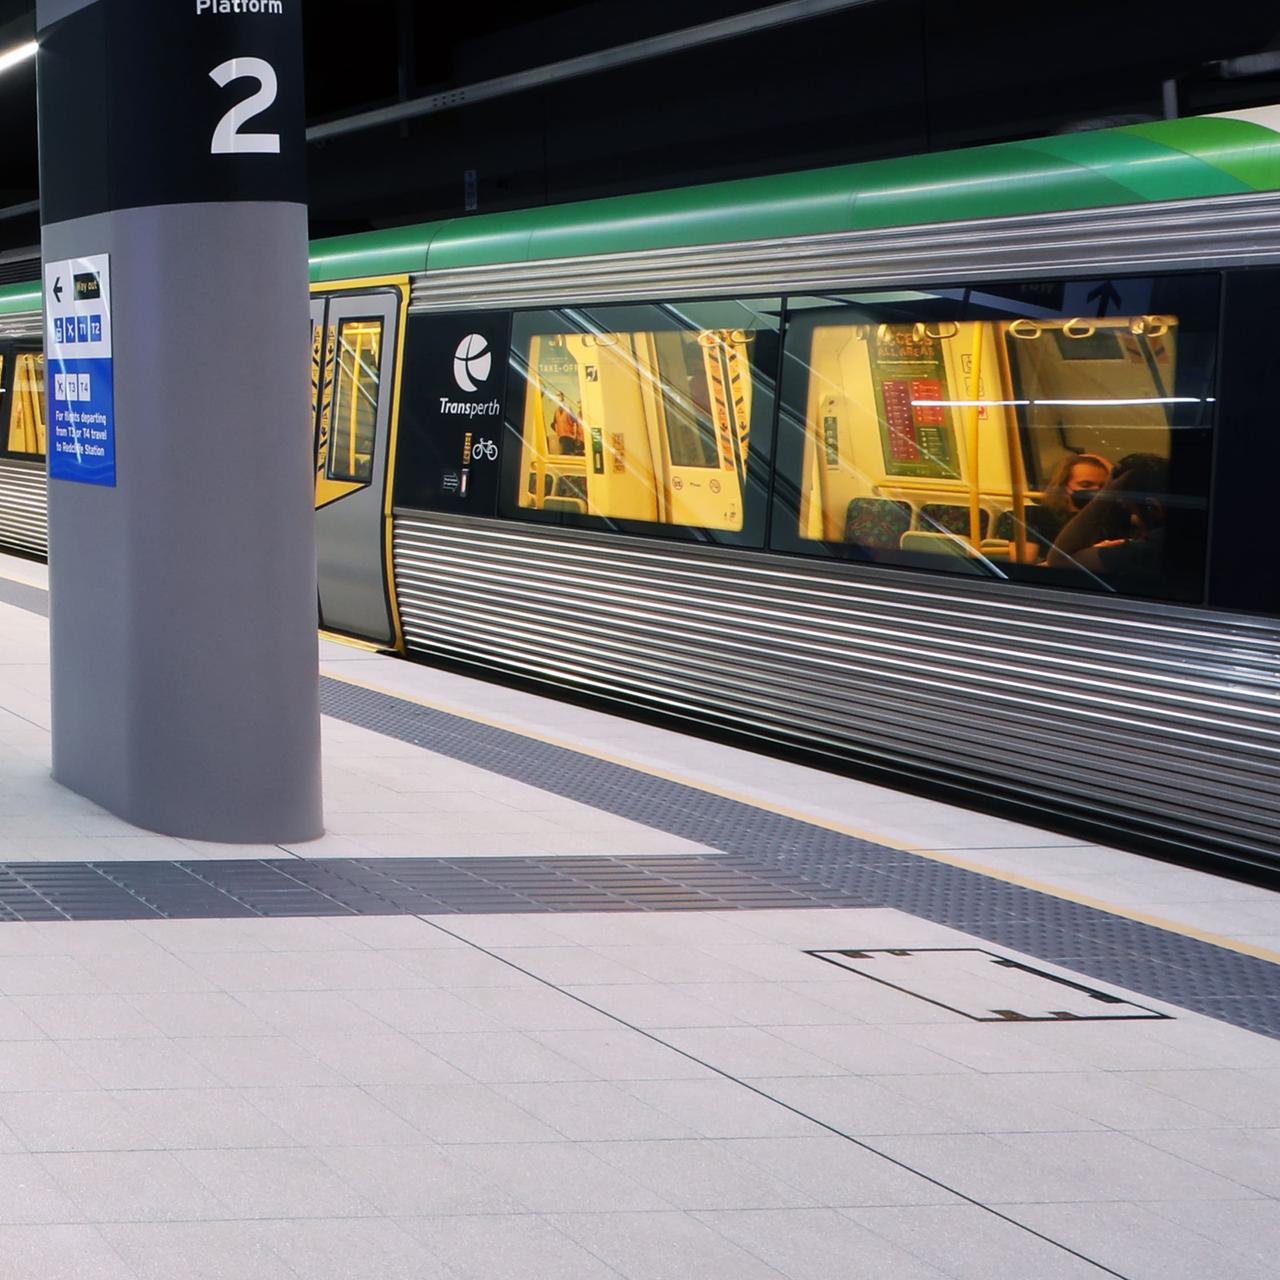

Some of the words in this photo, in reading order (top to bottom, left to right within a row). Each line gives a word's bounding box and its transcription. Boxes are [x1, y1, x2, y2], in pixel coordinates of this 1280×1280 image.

[208, 56, 281, 154] 2
[87, 280, 97, 290] out
[79, 323, 86, 335] T1
[91, 322, 100, 335] T2
[68, 381, 76, 393] T3
[80, 381, 88, 393] T4
[440, 397, 500, 419] Transperth
[55, 410, 64, 421] For
[80, 412, 107, 426] departing
[55, 425, 68, 437] from
[68, 427, 76, 438] T3
[82, 427, 90, 439] T4
[90, 428, 108, 440] travel
[56, 441, 62, 452] to
[84, 444, 105, 456] Station
